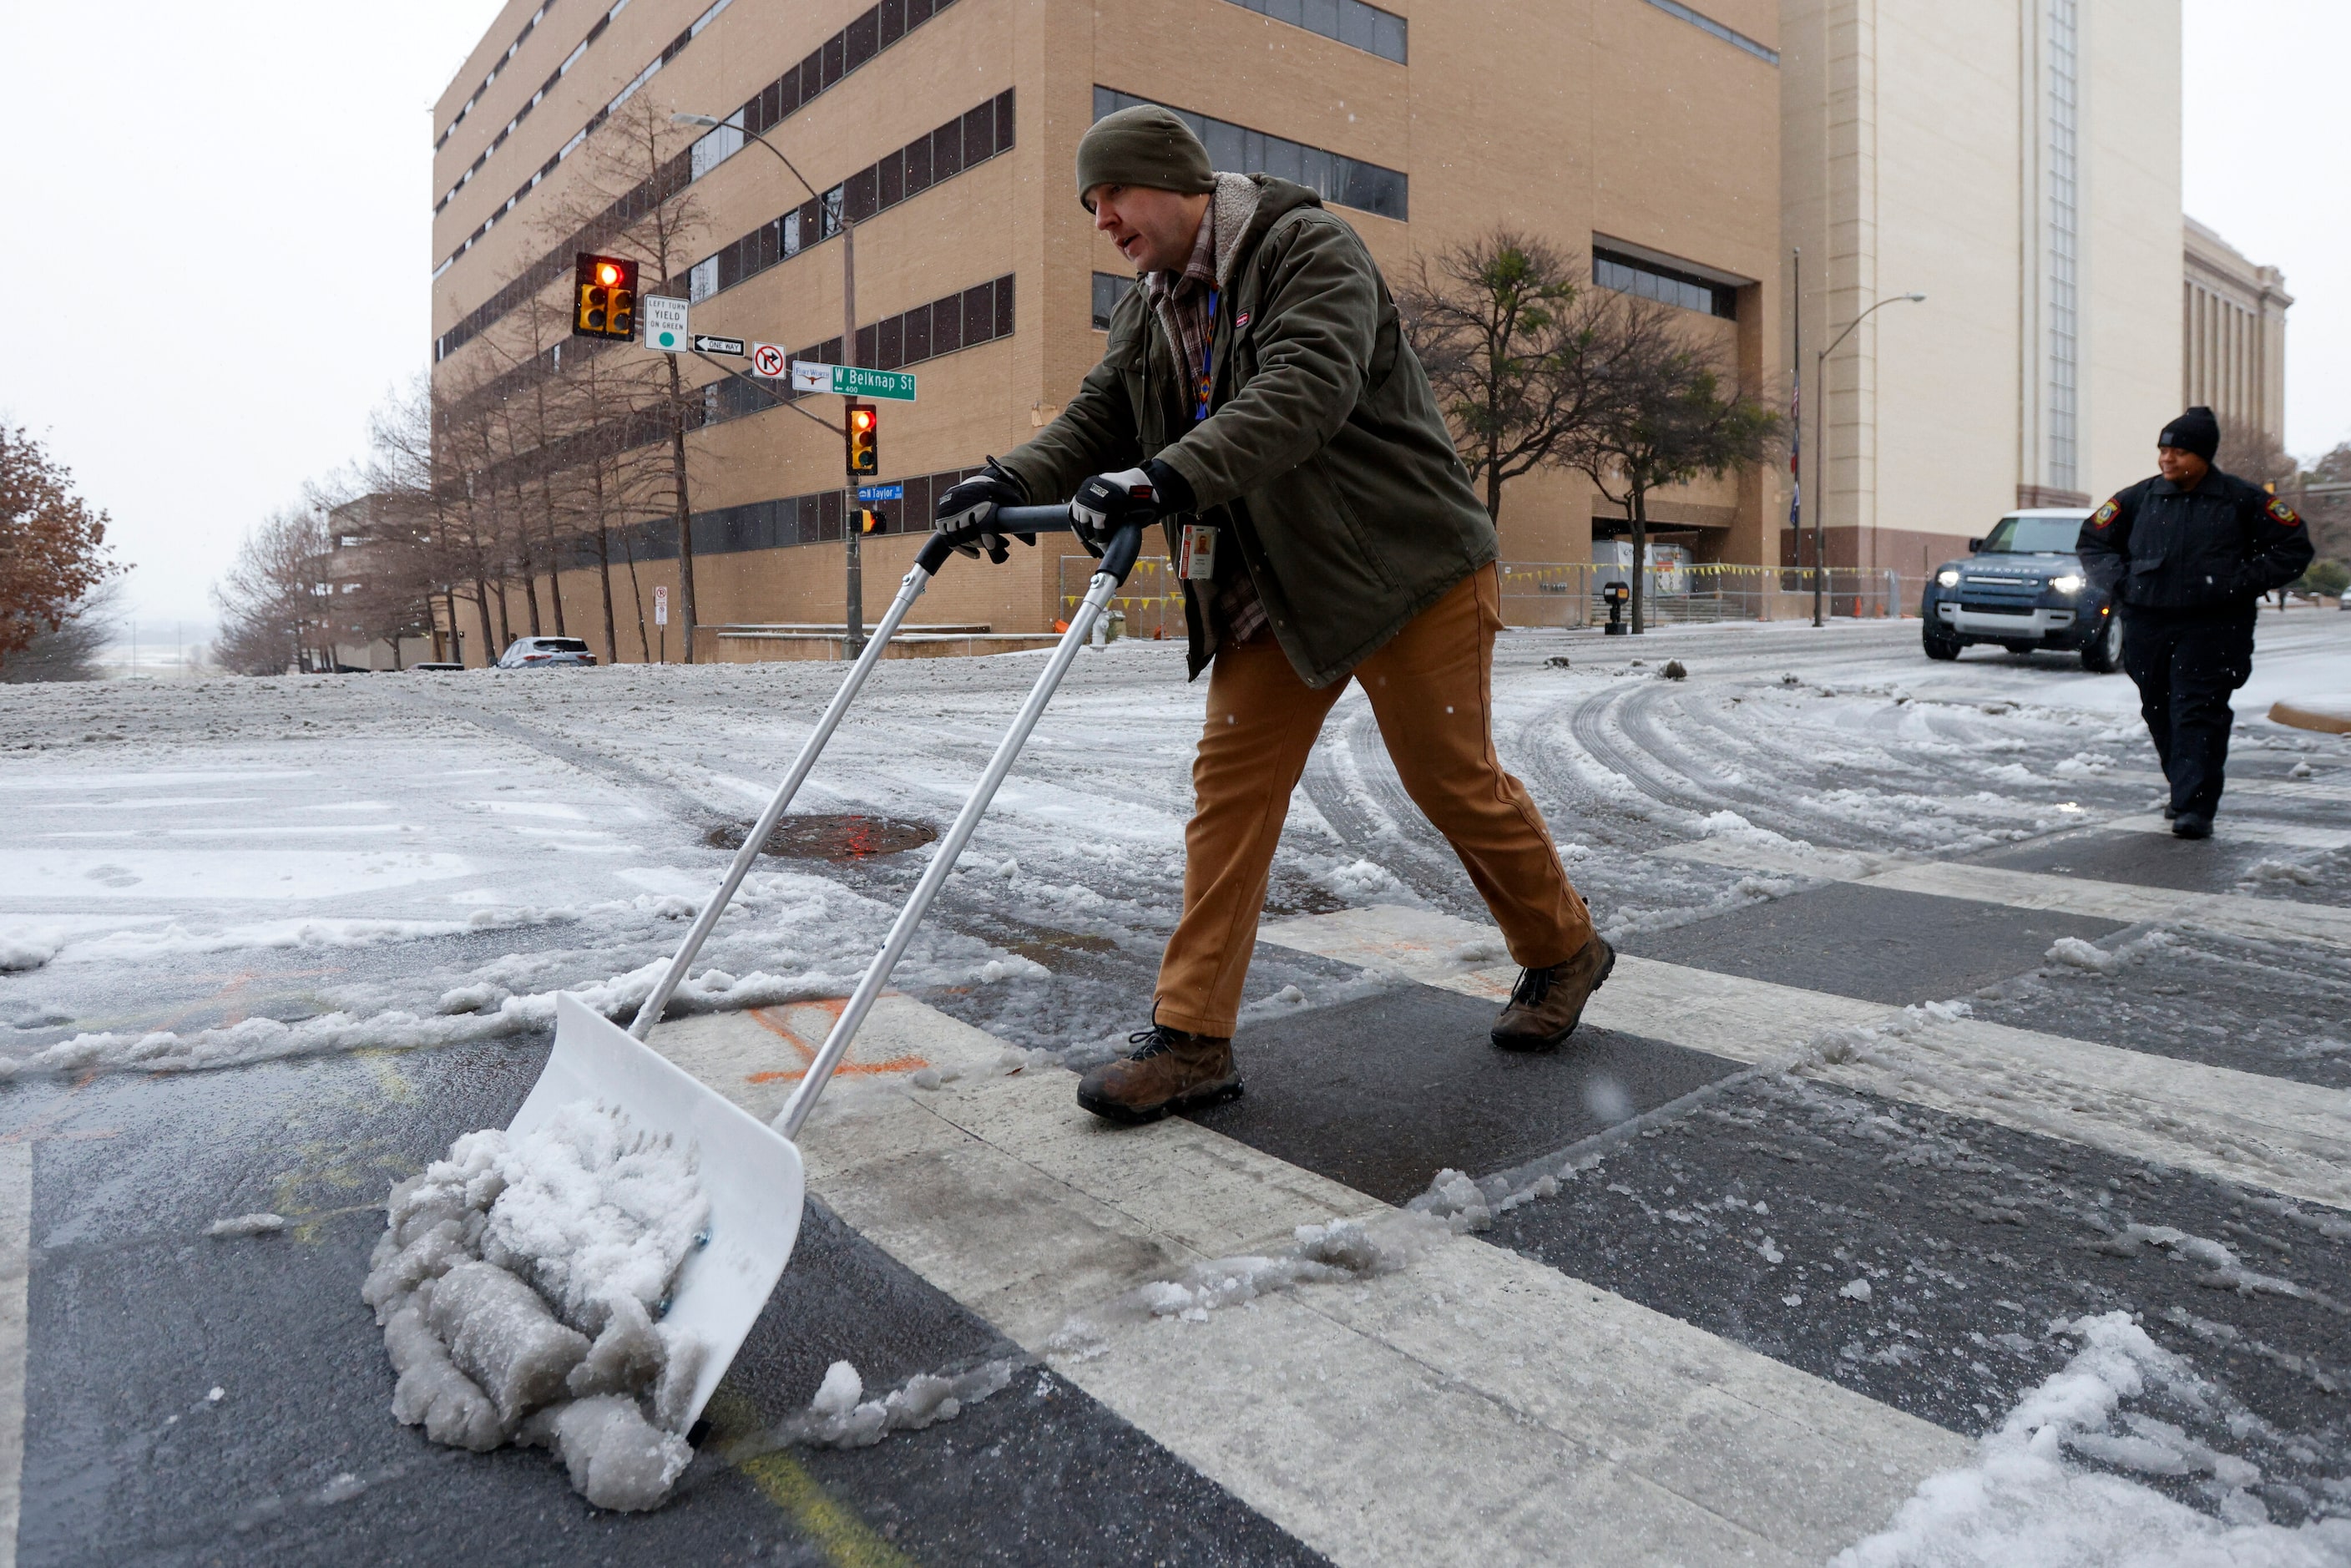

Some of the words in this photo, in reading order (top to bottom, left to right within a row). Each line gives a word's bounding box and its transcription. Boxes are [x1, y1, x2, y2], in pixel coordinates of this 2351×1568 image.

[649, 300, 665, 308] LEFT
[668, 301, 685, 311] TURN
[655, 310, 680, 321] YIELD
[650, 320, 660, 328] ON
[662, 321, 683, 331] GREEN
[709, 341, 723, 349] ONE
[725, 342, 739, 351] WAY
[796, 367, 809, 376] FORT
[810, 369, 830, 378] WORTH
[835, 367, 844, 383] W
[849, 370, 895, 392] Belknap
[900, 376, 913, 391] St
[867, 488, 871, 498] N
[872, 488, 893, 500] Taylor
